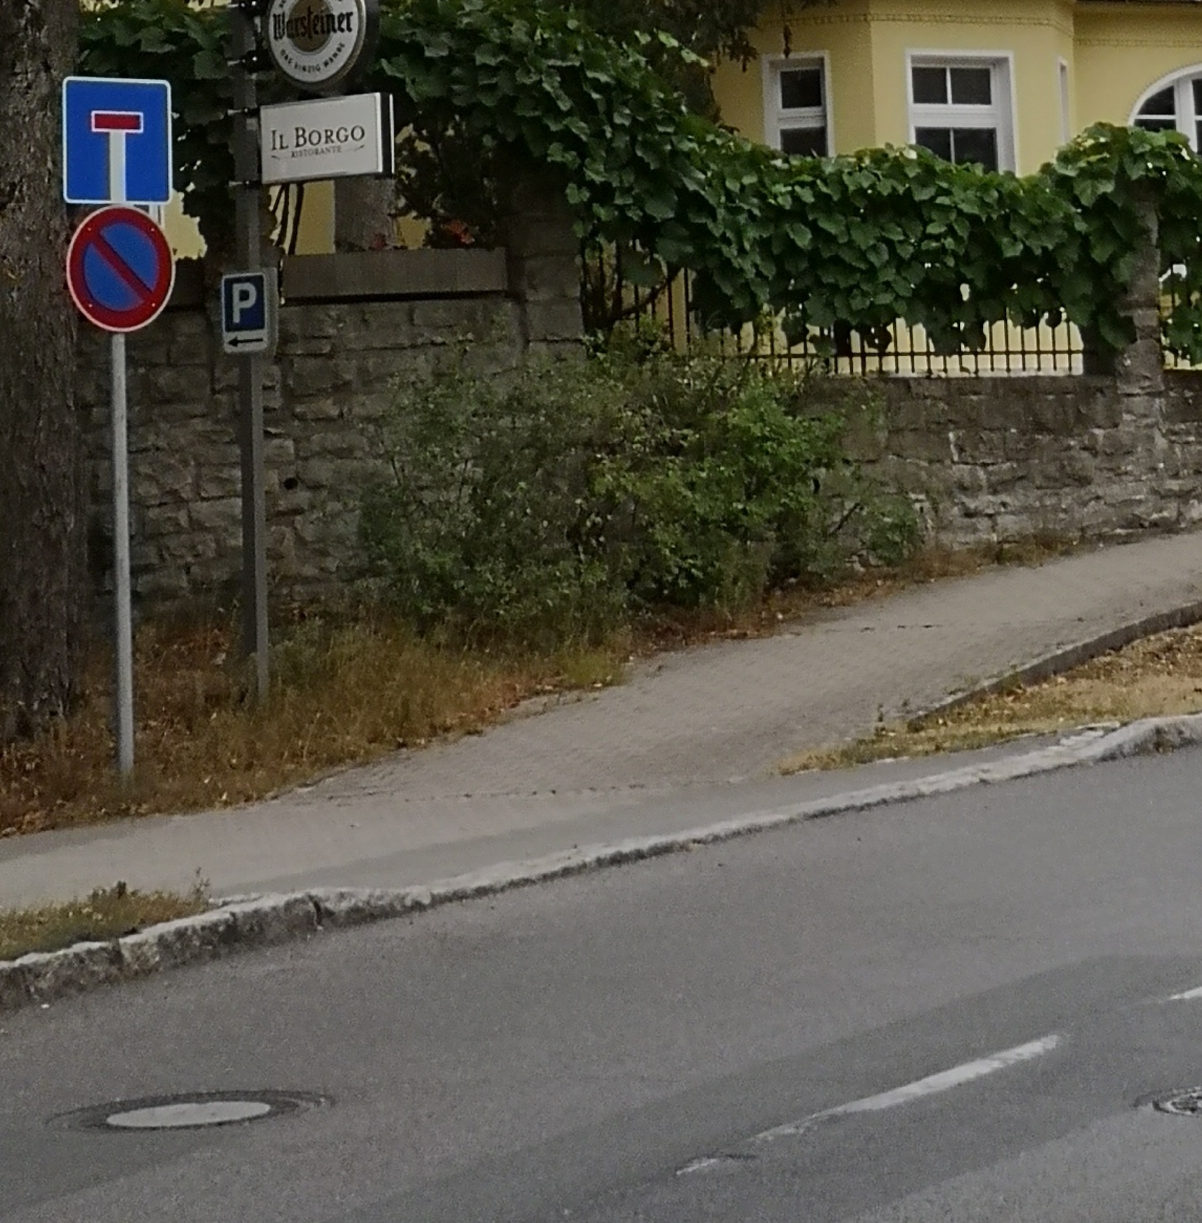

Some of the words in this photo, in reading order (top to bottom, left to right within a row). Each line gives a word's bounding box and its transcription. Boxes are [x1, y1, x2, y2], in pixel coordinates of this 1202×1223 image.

[272, 5, 354, 41] Warsteiner
[271, 129, 289, 151] IL
[294, 125, 366, 148] BORGO
[291, 145, 342, 158] RISTORANTE
[232, 282, 257, 324] P
